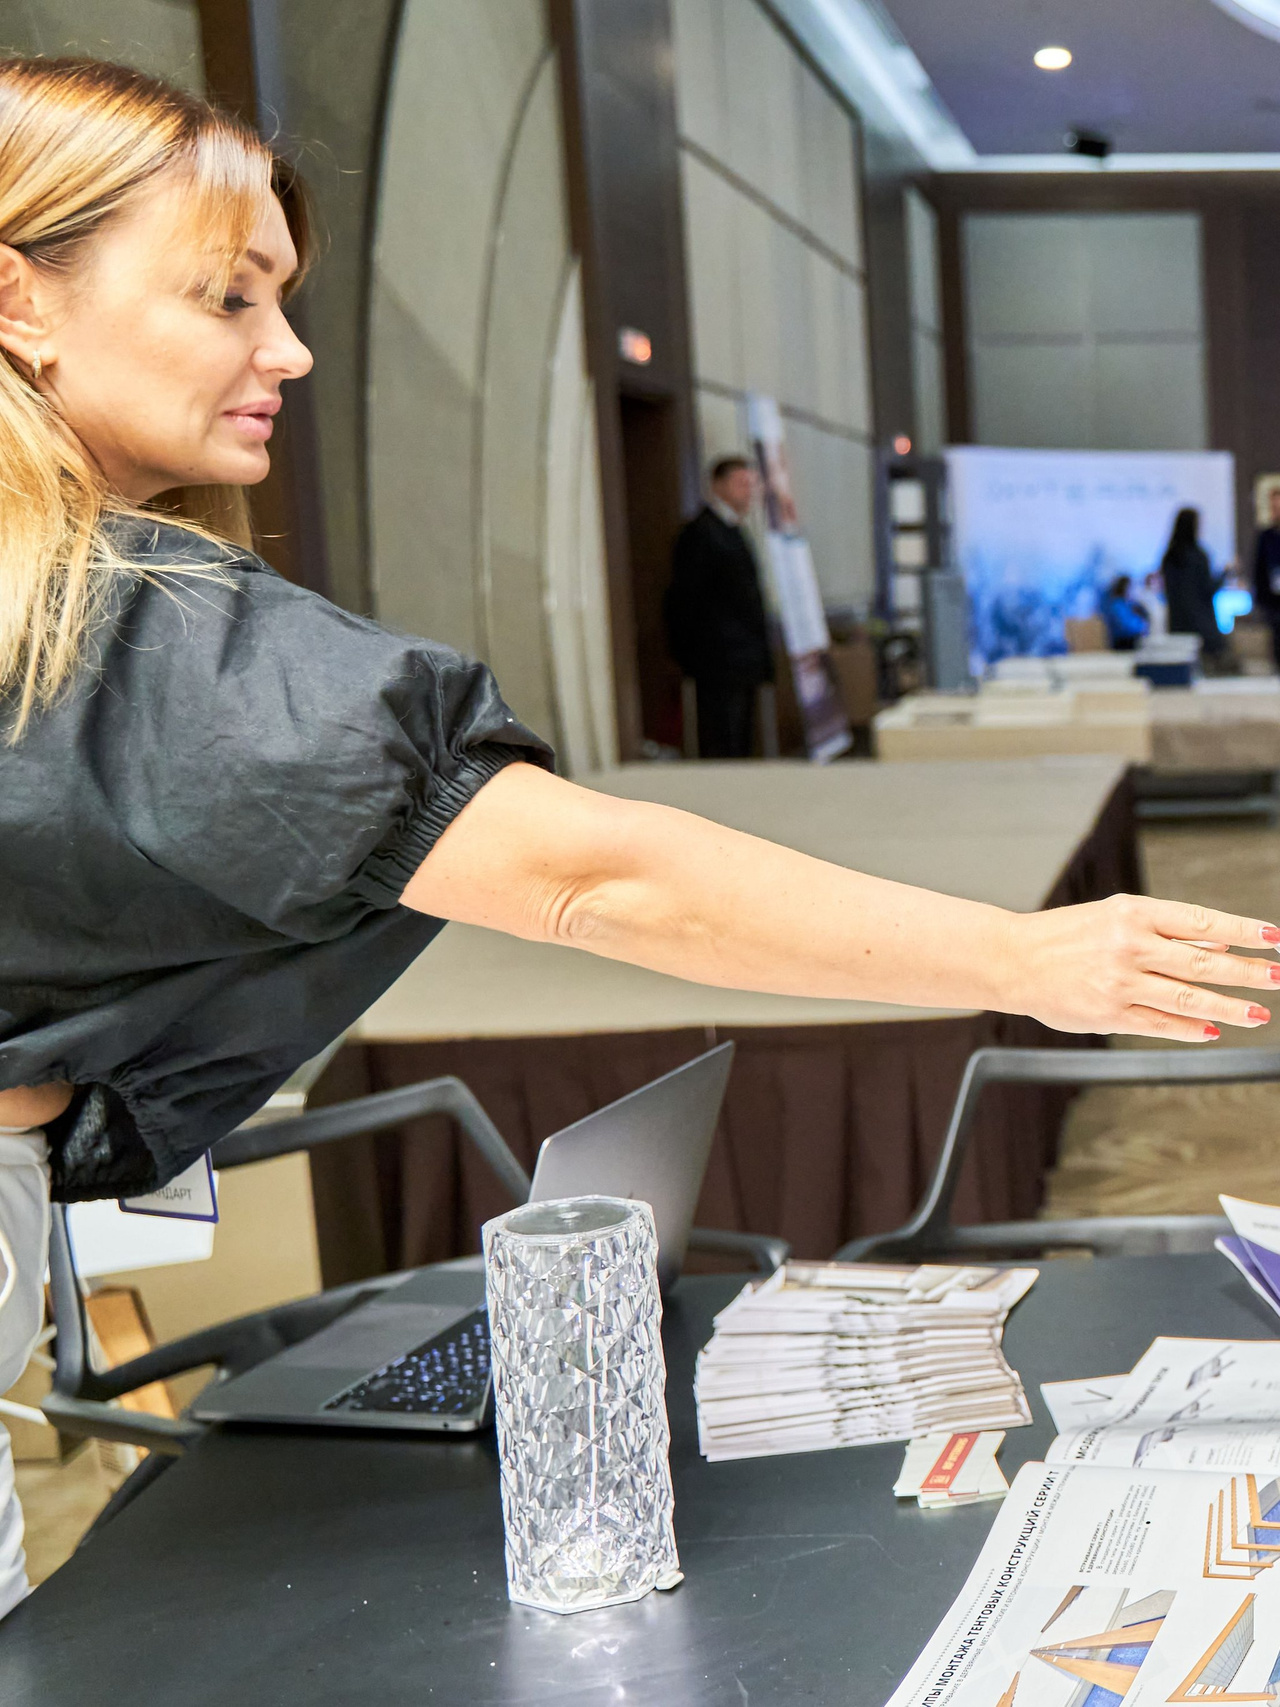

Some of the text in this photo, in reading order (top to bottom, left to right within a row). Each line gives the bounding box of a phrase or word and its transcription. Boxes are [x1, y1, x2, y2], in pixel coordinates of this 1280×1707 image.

[936, 1638, 975, 1686] МОНТАЖА
[967, 1590, 1005, 1635] ТЕНТОВЫХ
[997, 1510, 1040, 1587] КОНСТРУКЦИЙ
[1034, 1477, 1054, 1507] СЕРИИ
[979, 1608, 1007, 1646] МЕТАЛЛИЧЕСКИЕ
[1005, 1578, 1024, 1603] БЕТОННЫЕ
[1020, 1538, 1040, 1577] КОНСТРУКЦИИ
[1038, 1511, 1052, 1534] МОНТАЖ
